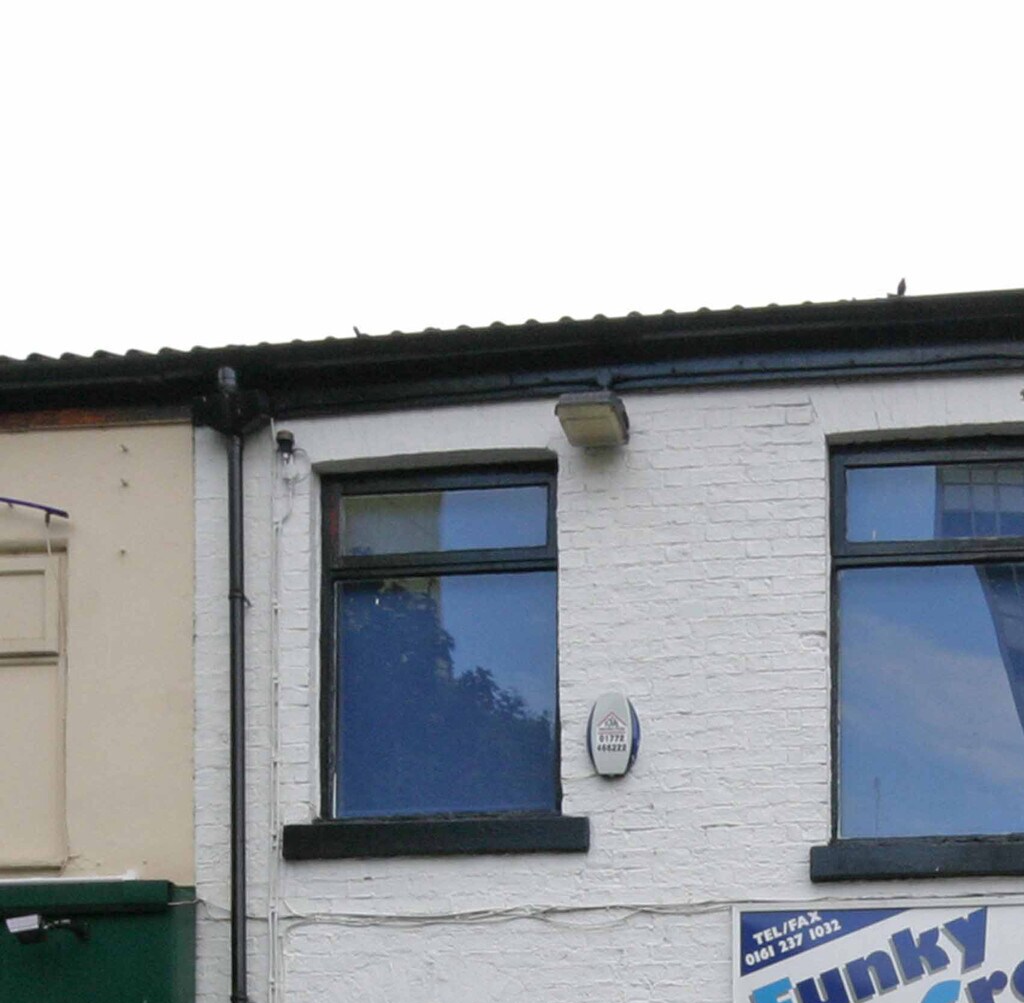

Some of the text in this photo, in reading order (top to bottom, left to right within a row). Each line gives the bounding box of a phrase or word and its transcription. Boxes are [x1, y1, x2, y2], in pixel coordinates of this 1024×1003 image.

[745, 919, 842, 966] 0161 237 1032
[752, 911, 822, 945] TEL/FAX
